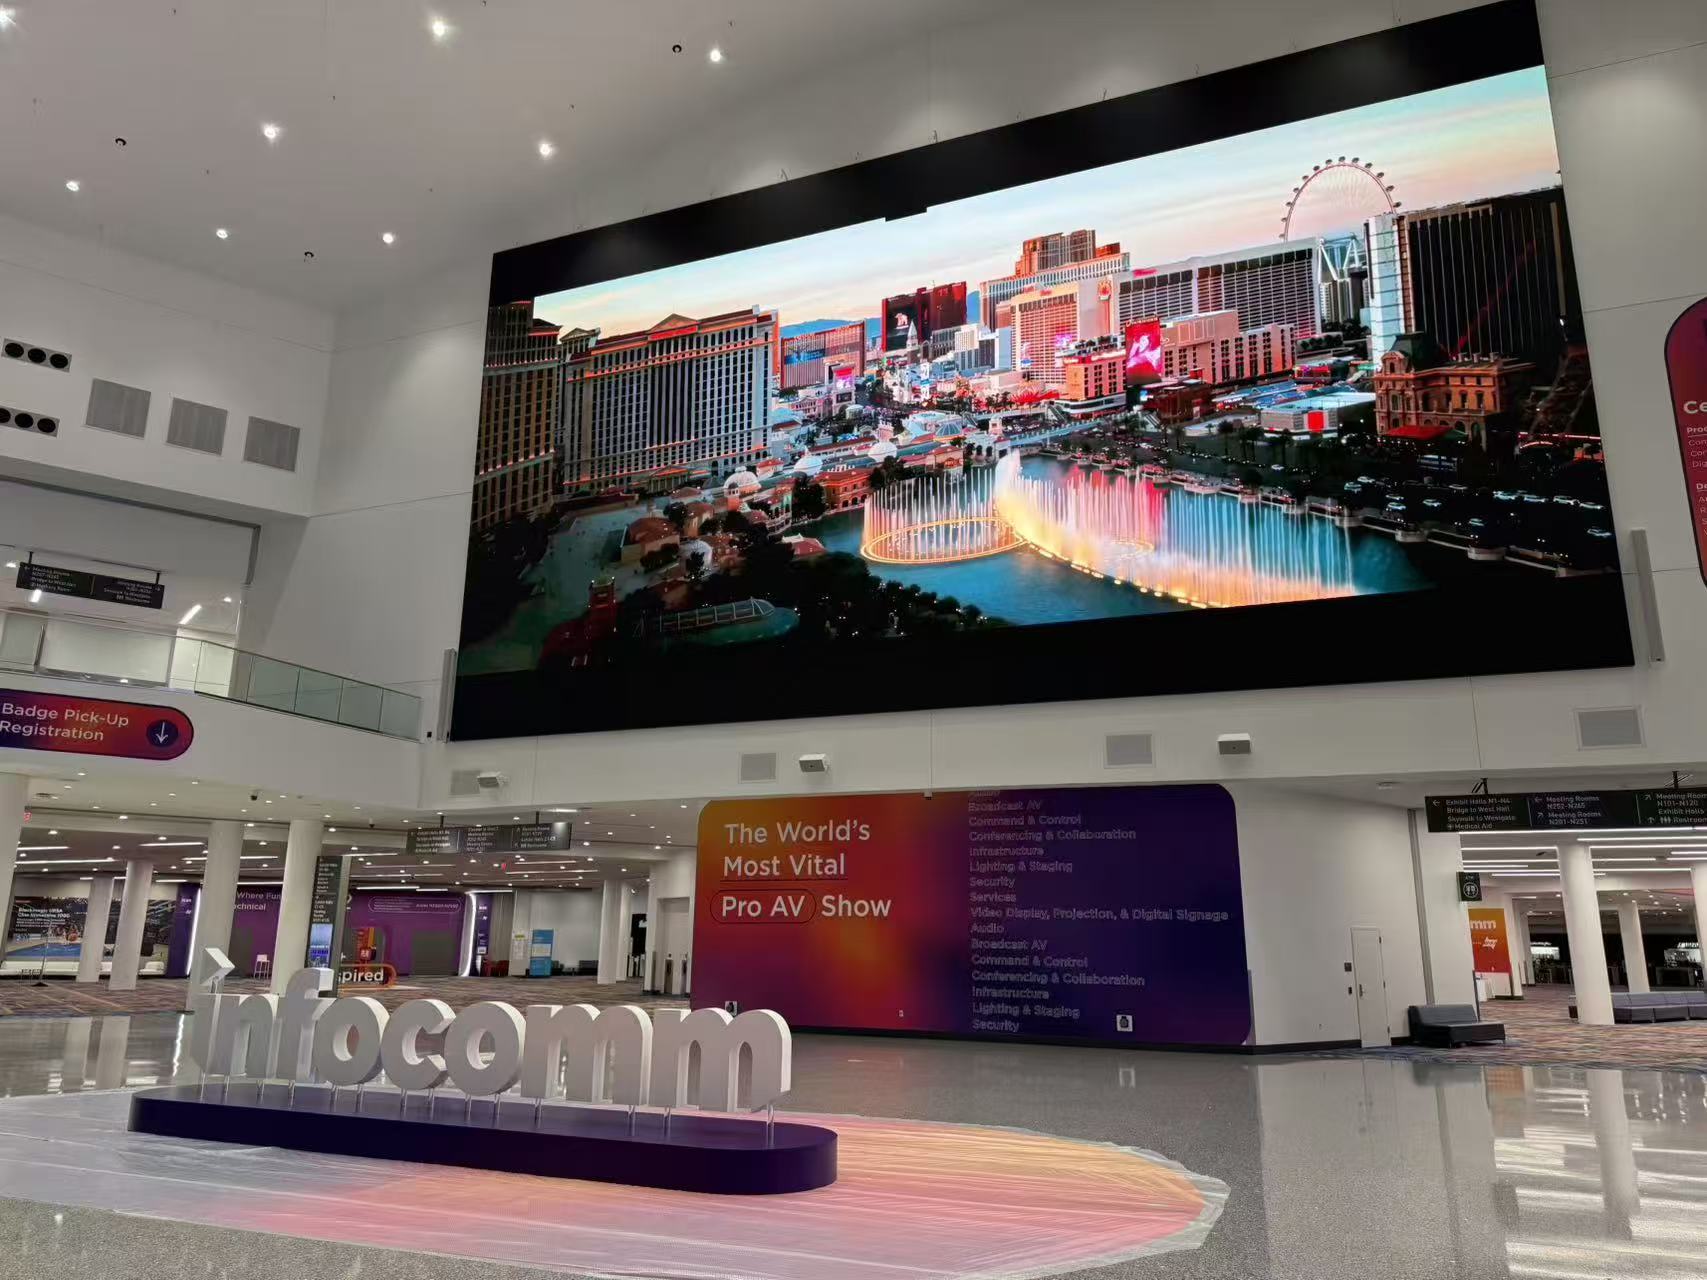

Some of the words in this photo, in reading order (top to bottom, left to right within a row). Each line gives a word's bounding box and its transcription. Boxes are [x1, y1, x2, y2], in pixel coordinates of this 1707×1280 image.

[2, 703, 59, 720] Badge
[64, 708, 129, 728] Pick-Up
[0, 720, 104, 741] Registration
[1547, 796, 1574, 804] Meeting
[1657, 793, 1685, 801] Meeting
[969, 816, 1024, 826] Command
[1028, 816, 1036, 825] &
[1039, 814, 1081, 826] Control
[724, 823, 768, 844] The
[776, 819, 870, 843] World's
[969, 831, 1042, 842] Conferencing
[1046, 831, 1054, 840] &
[1057, 829, 1136, 841] Collaboration
[969, 846, 1044, 857] Infrastructure
[723, 855, 780, 877] Most
[789, 853, 845, 876] Vital
[969, 861, 1016, 873] Lighting
[1018, 861, 1026, 871] &
[1030, 860, 1073, 873] Staging
[969, 877, 1015, 888] Security
[969, 892, 1016, 902] Services
[722, 896, 762, 917] Pro
[770, 895, 805, 917] AV
[821, 895, 891, 917] Show
[970, 907, 1002, 918] Video
[1006, 908, 1050, 920] Display,
[1053, 908, 1117, 920] Projection,
[1120, 908, 1129, 919] &
[1132, 908, 1172, 921] Digital
[1176, 908, 1229, 922] Signage
[970, 922, 1004, 933] Audio
[971, 938, 1030, 949] Broadcast
[1031, 939, 1048, 950] AV
[971, 955, 1029, 966] Command
[1033, 956, 1041, 966] &
[1043, 956, 1088, 968] Control
[971, 970, 1048, 985] Conferencing
[1051, 973, 1060, 984] &
[1063, 973, 1145, 986] Collaboration
[972, 986, 1049, 999] Infrastructure
[972, 1002, 1019, 1016] Lighting
[1023, 1004, 1031, 1015] &
[1034, 1004, 1080, 1020] Staging
[197, 948, 792, 1112] infocomm
[972, 1019, 1019, 1032] Security
